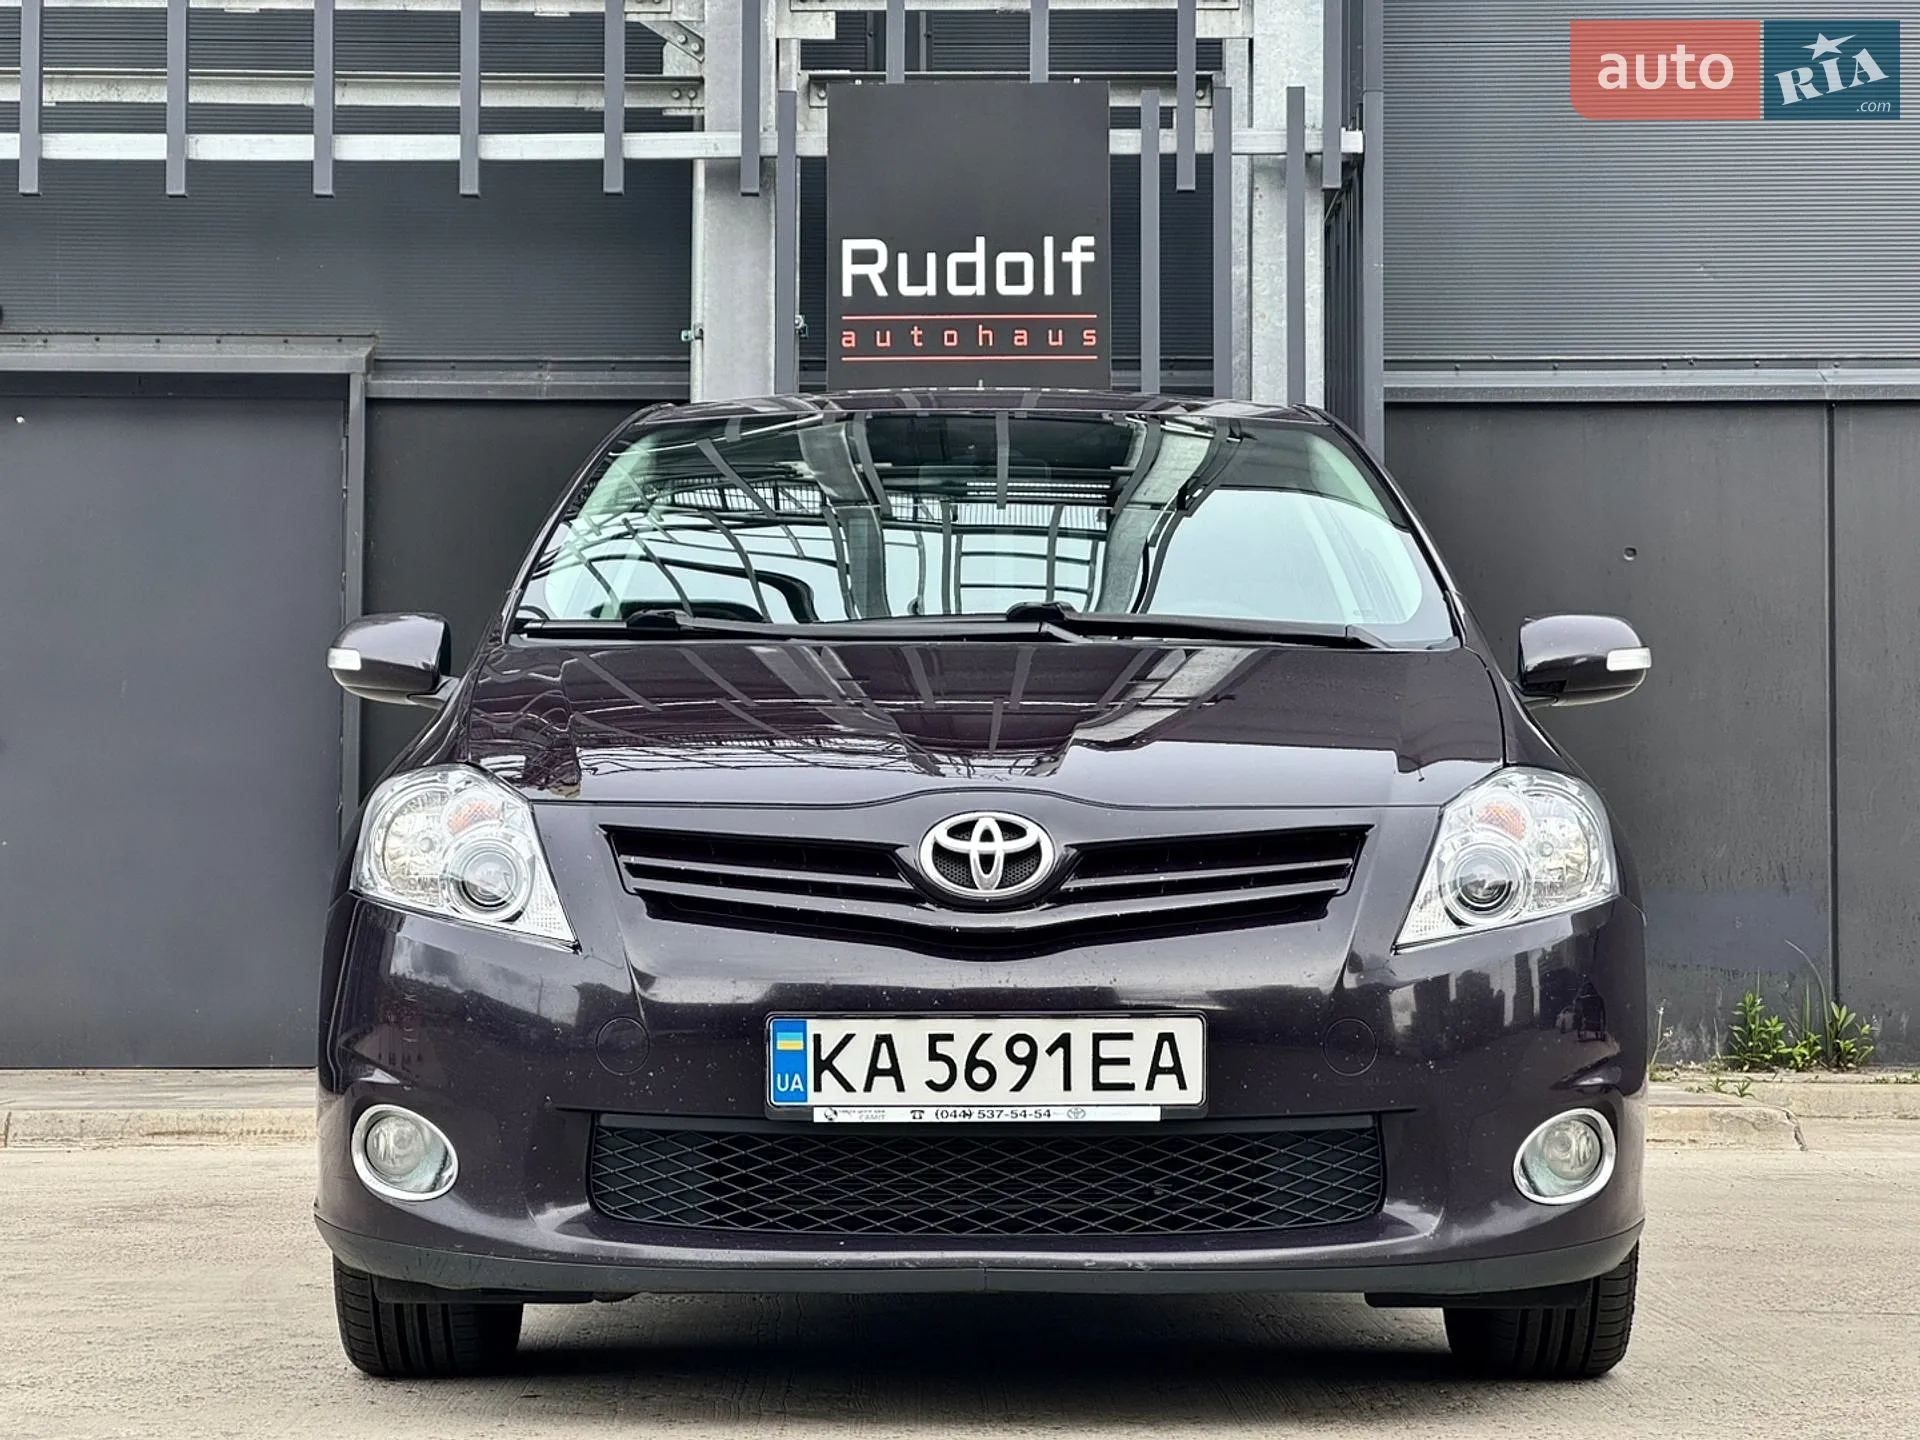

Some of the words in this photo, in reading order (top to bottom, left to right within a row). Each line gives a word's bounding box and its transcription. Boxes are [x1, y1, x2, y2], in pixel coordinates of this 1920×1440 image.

[842, 236, 1095, 296] Rudolf
[841, 324, 1097, 347] autohaus
[813, 1033, 905, 1093] KA
[777, 1075, 804, 1092] UA
[977, 1109, 1051, 1120] 537-54-54
